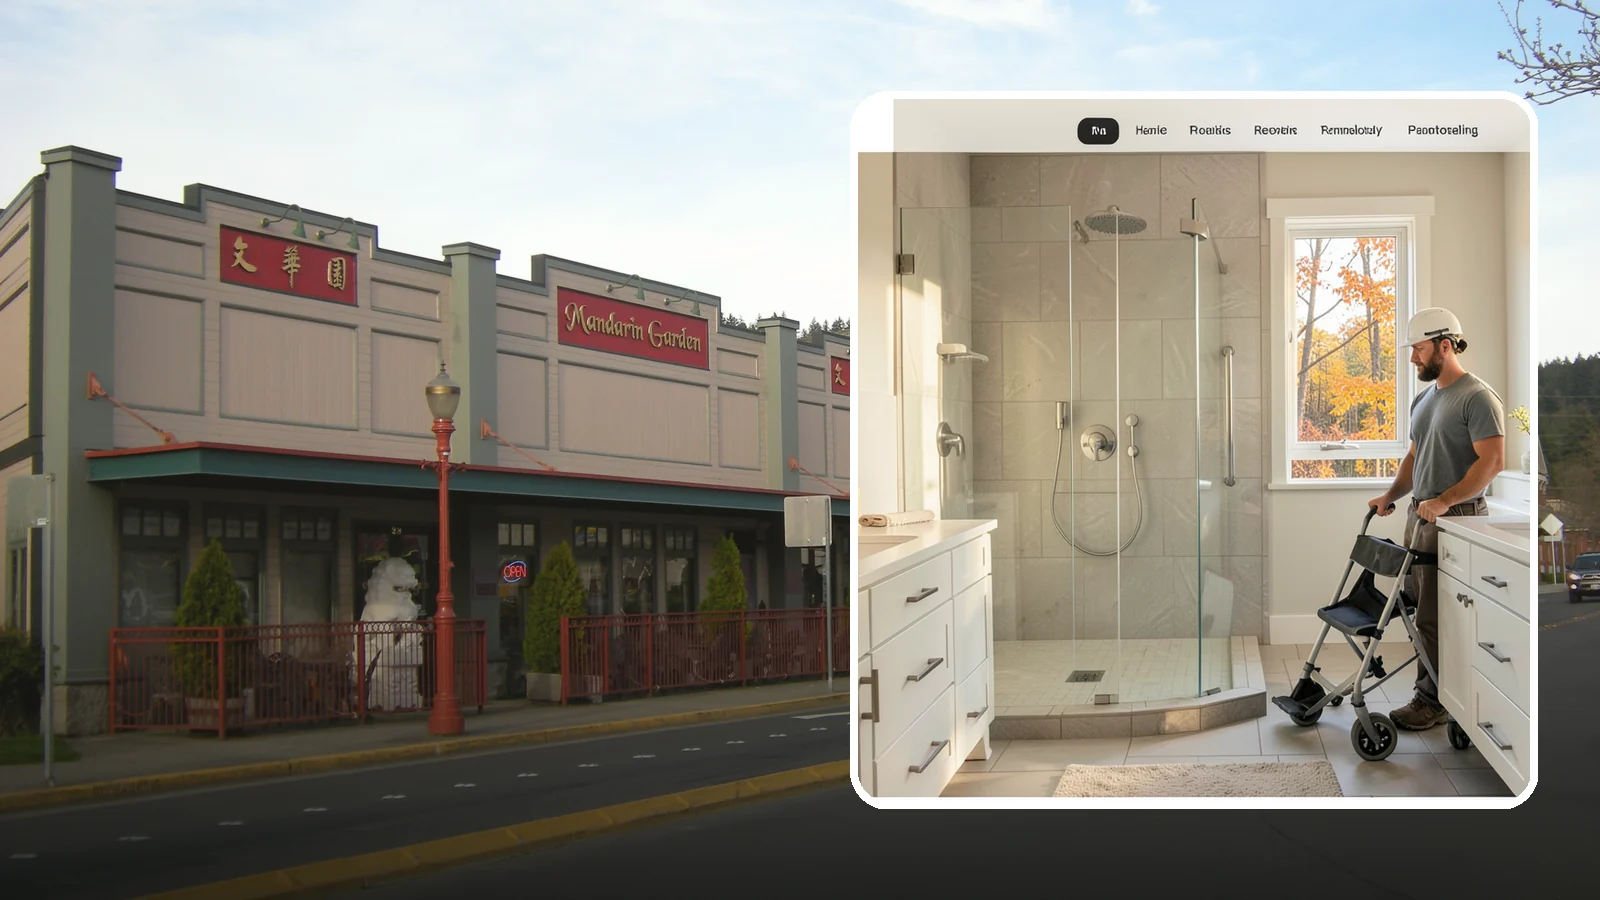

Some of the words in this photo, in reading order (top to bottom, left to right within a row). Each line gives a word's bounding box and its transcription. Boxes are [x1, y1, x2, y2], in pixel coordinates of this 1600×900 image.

[230, 235, 347, 291] 文華園
[564, 302, 644, 341] Mandarin
[647, 320, 702, 352] Garden
[503, 565, 527, 578] OPEN
